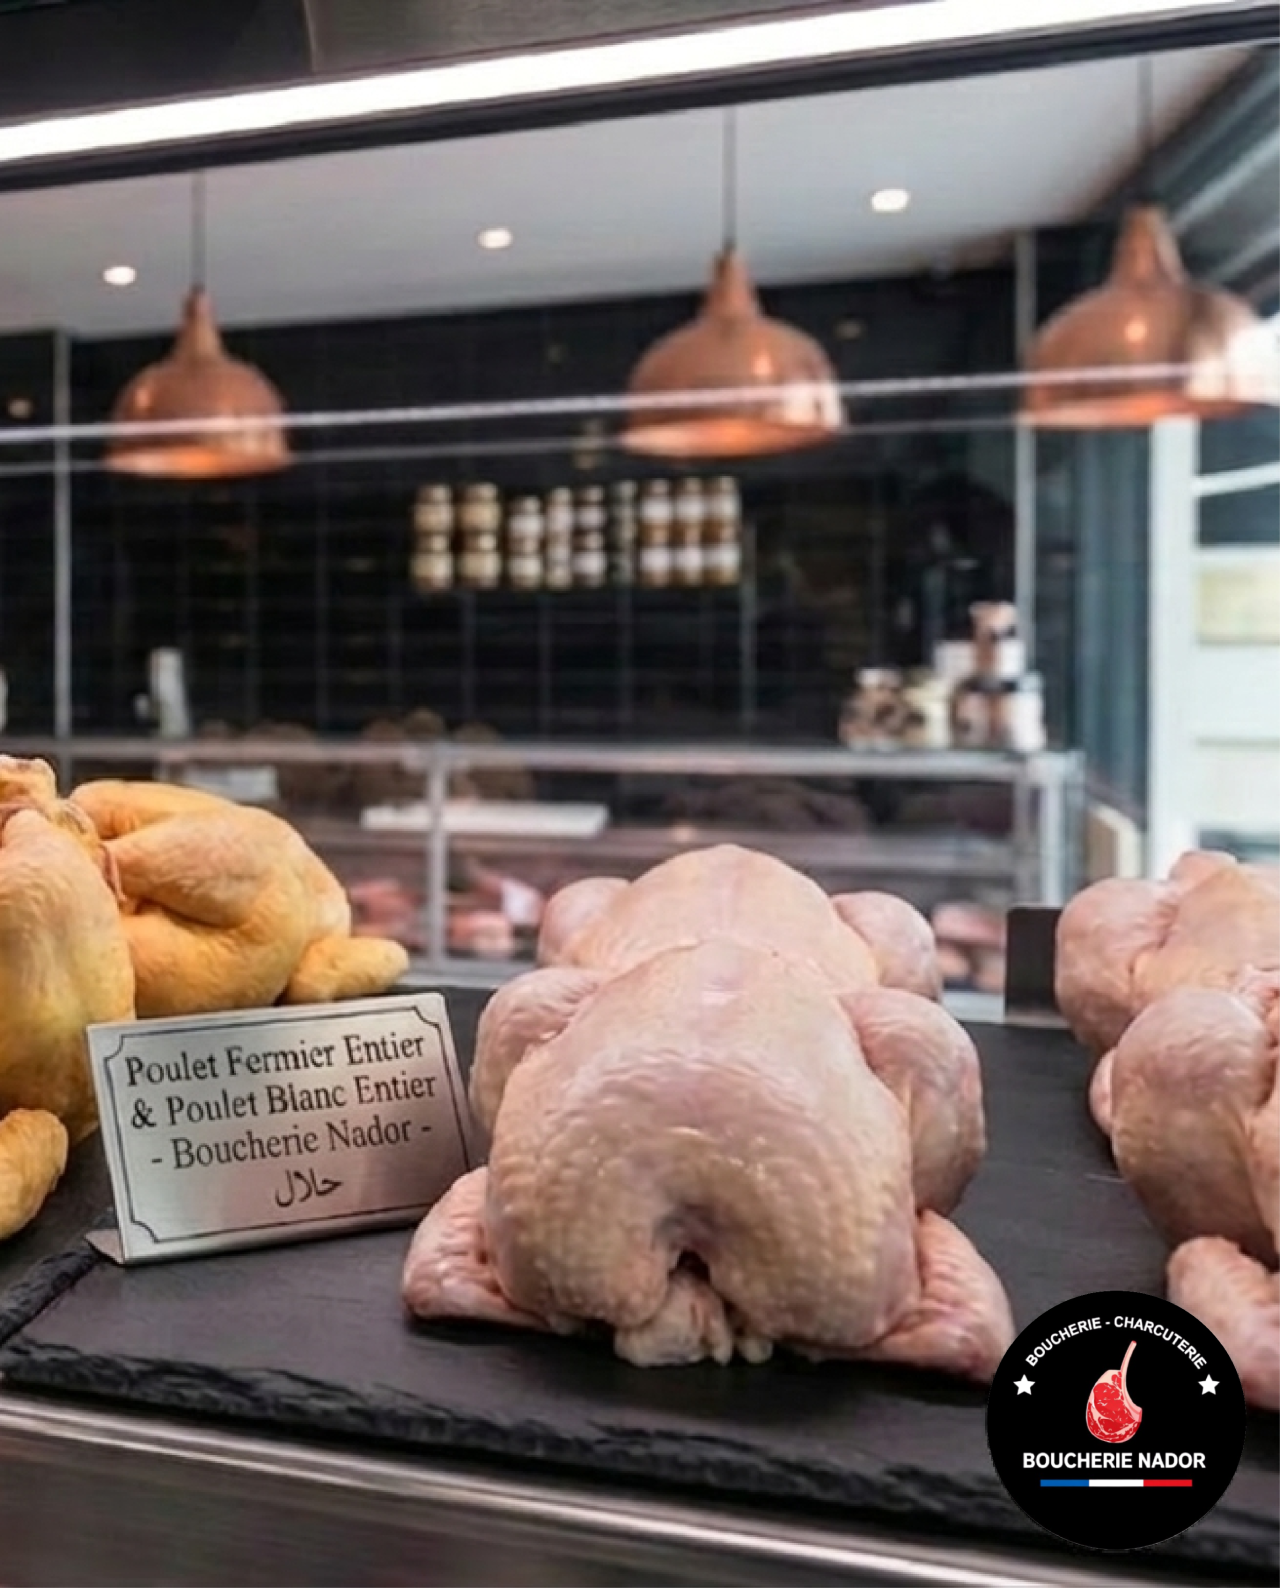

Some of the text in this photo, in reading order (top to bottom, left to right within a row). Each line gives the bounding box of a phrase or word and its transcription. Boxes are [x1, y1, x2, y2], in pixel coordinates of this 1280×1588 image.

[125, 1032, 424, 1087] Poulet Fermier Entier
[131, 1071, 437, 1129] & Poulet Blanc Entier
[171, 1124, 319, 1169] Boucherie
[326, 1114, 411, 1151] Nador
[275, 1168, 343, 1208] حلال
